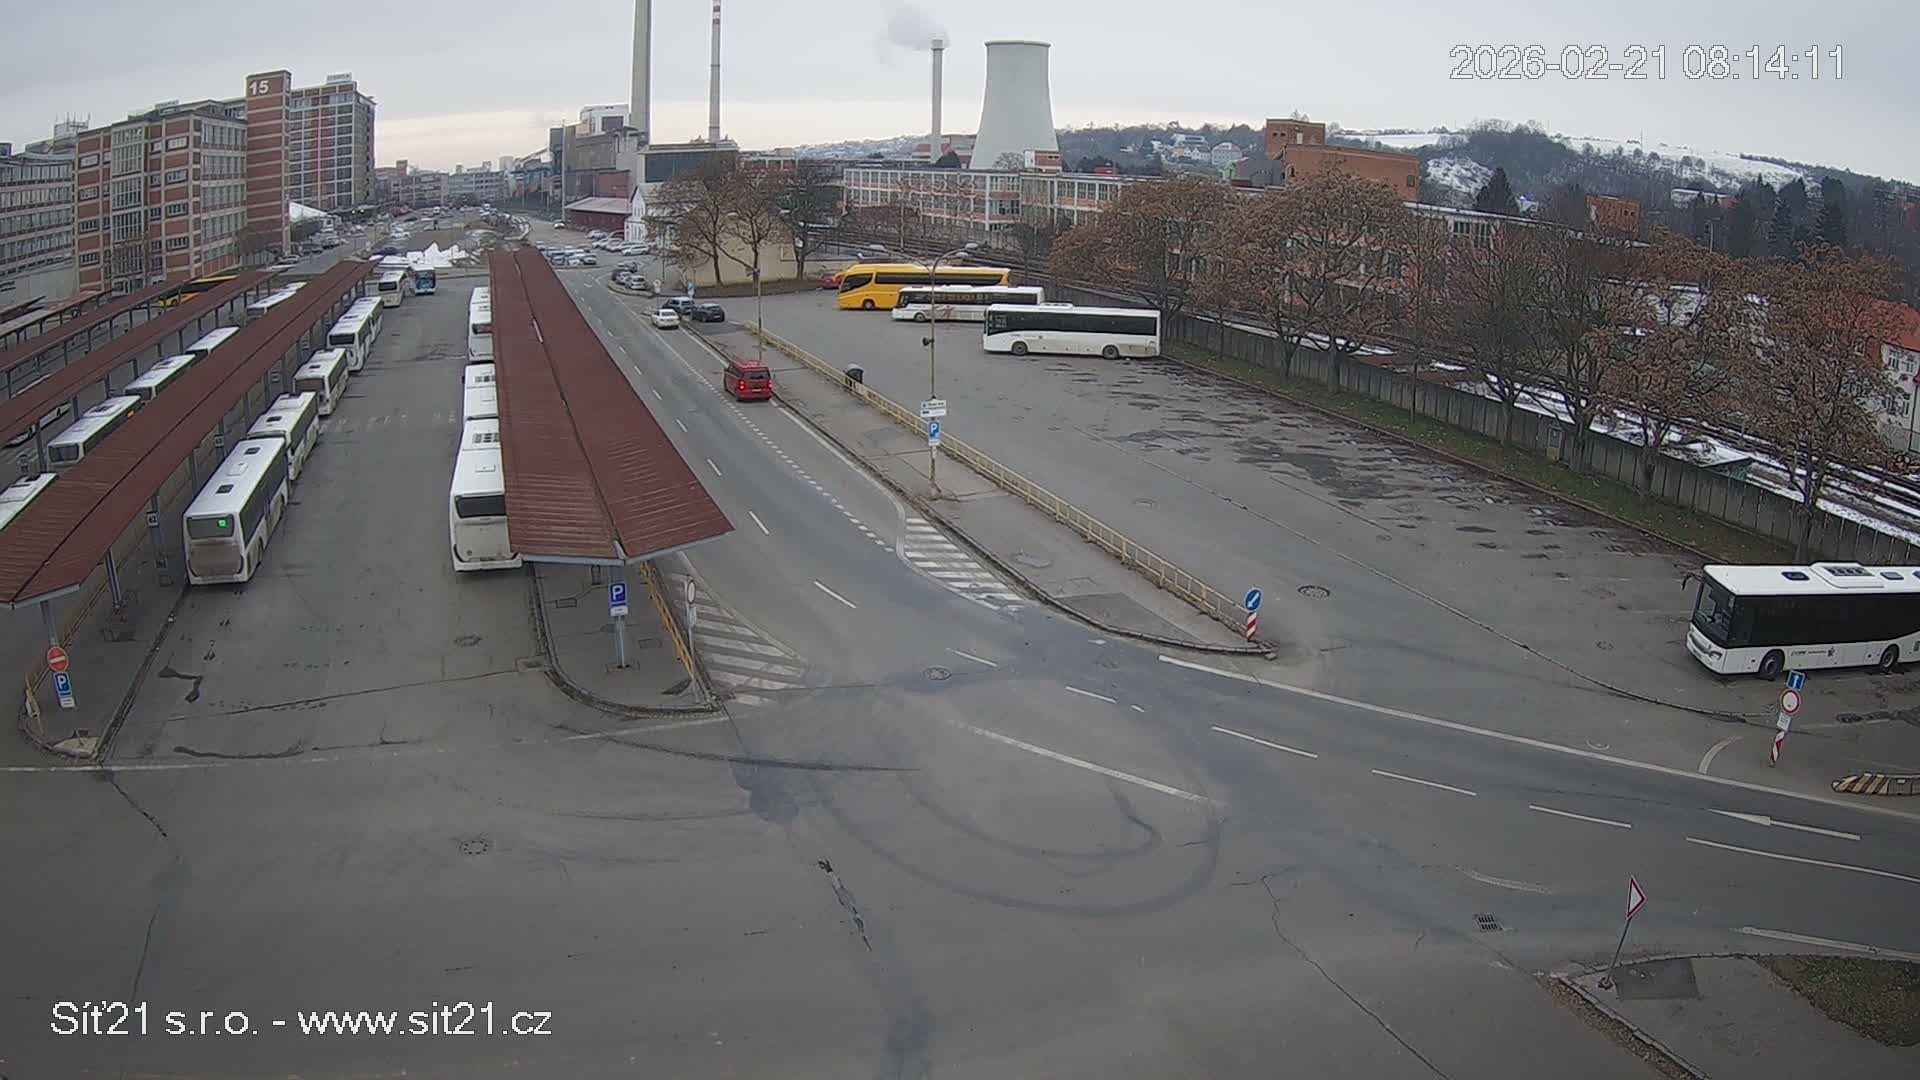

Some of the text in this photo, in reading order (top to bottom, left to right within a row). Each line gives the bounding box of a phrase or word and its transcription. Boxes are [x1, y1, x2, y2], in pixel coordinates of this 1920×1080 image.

[248, 80, 270, 95] 15
[612, 585, 624, 600] P
[57, 675, 67, 689] P
